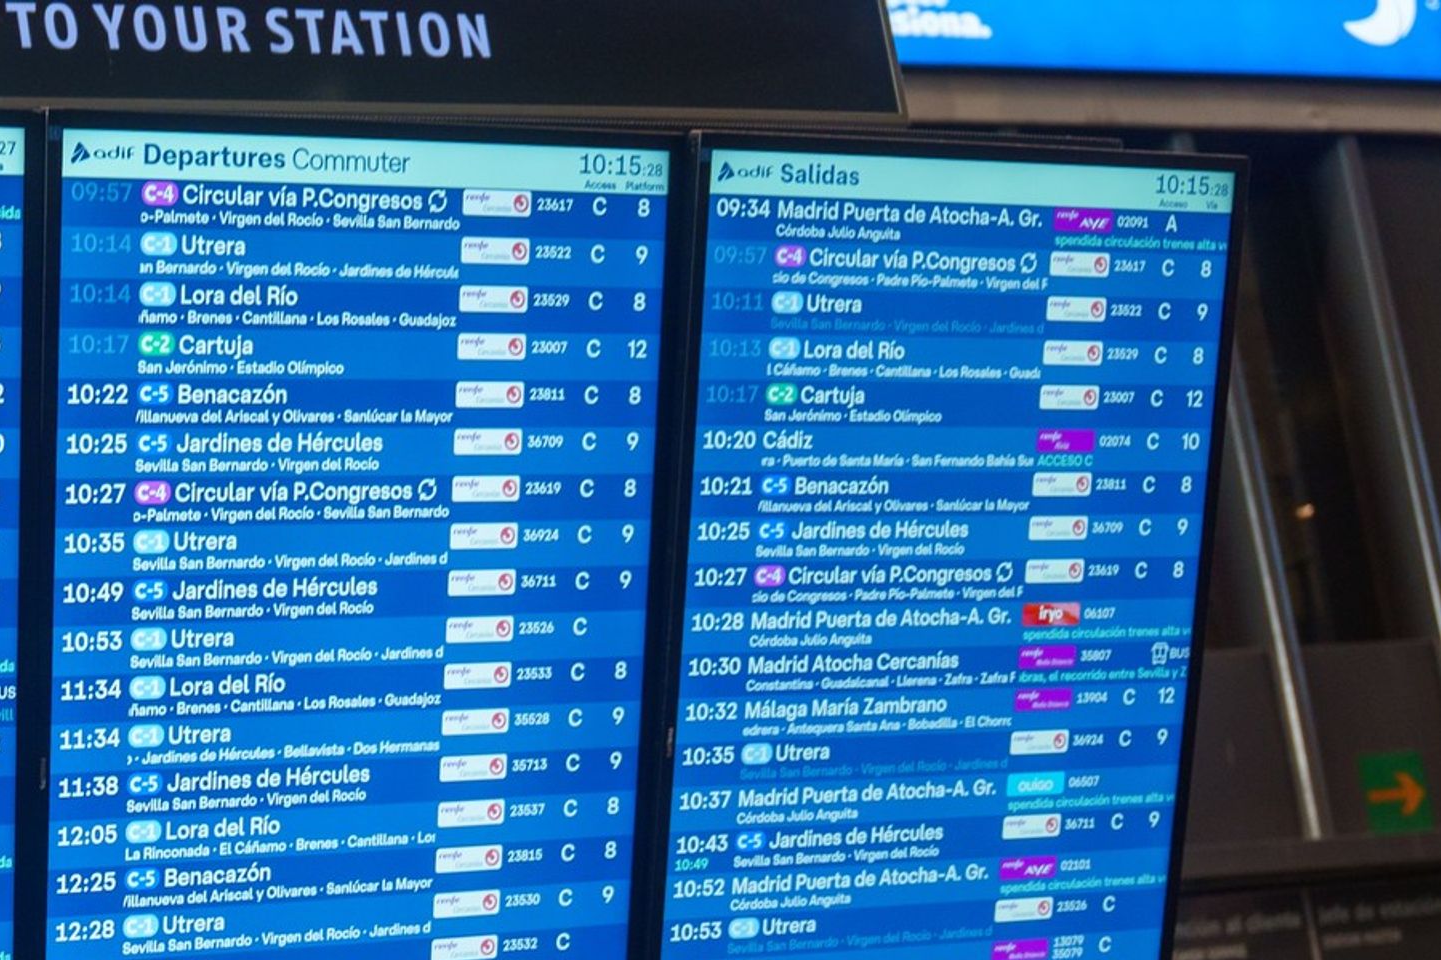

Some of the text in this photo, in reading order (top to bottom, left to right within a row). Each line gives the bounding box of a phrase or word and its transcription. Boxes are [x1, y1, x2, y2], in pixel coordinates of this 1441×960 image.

[6, 2, 78, 49] TO
[92, 4, 251, 52] YOUR
[264, 7, 491, 58] STATION
[93, 143, 665, 179] adif Departures Commuter 10:15:28
[584, 179, 666, 193] Access Platform
[737, 163, 1231, 198] adif Salidas 10:15:28
[67, 383, 641, 404] 10:22 C-5 Benacazón 23811 C 8
[61, 661, 627, 701] 11:34 Lora del Río 23533 C 8
[685, 696, 947, 722] 10:32 Málaga María Zambrano
[125, 834, 409, 861] La Rinconada El Cáñamo Brenes Cantillana
